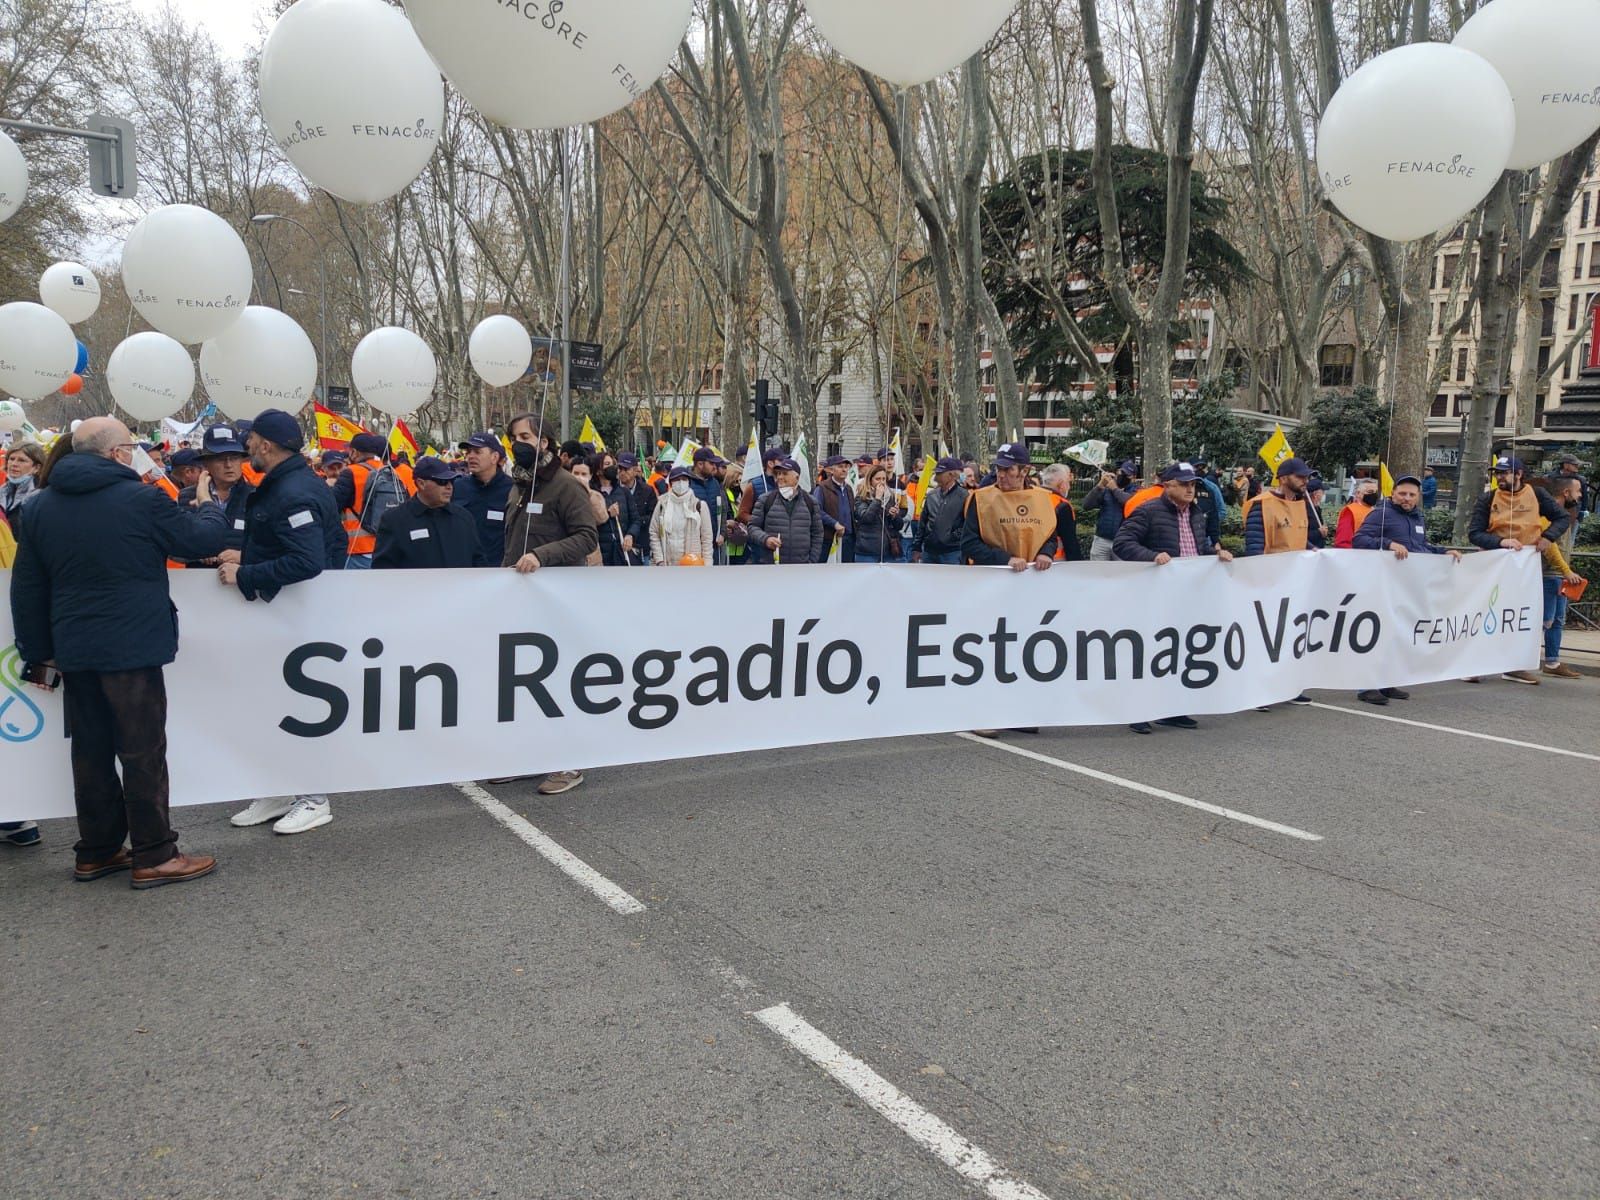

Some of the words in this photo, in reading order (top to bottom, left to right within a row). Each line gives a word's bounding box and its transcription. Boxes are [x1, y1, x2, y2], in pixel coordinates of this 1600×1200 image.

[352, 118, 435, 139] FENACORE
[1387, 154, 1475, 178] FENACORE
[1413, 584, 1531, 646] FENACORE
[278, 637, 458, 738] Sin
[497, 617, 881, 730] Regadío,
[906, 609, 1246, 689] Estómago
[1253, 592, 1381, 664] Vacío
